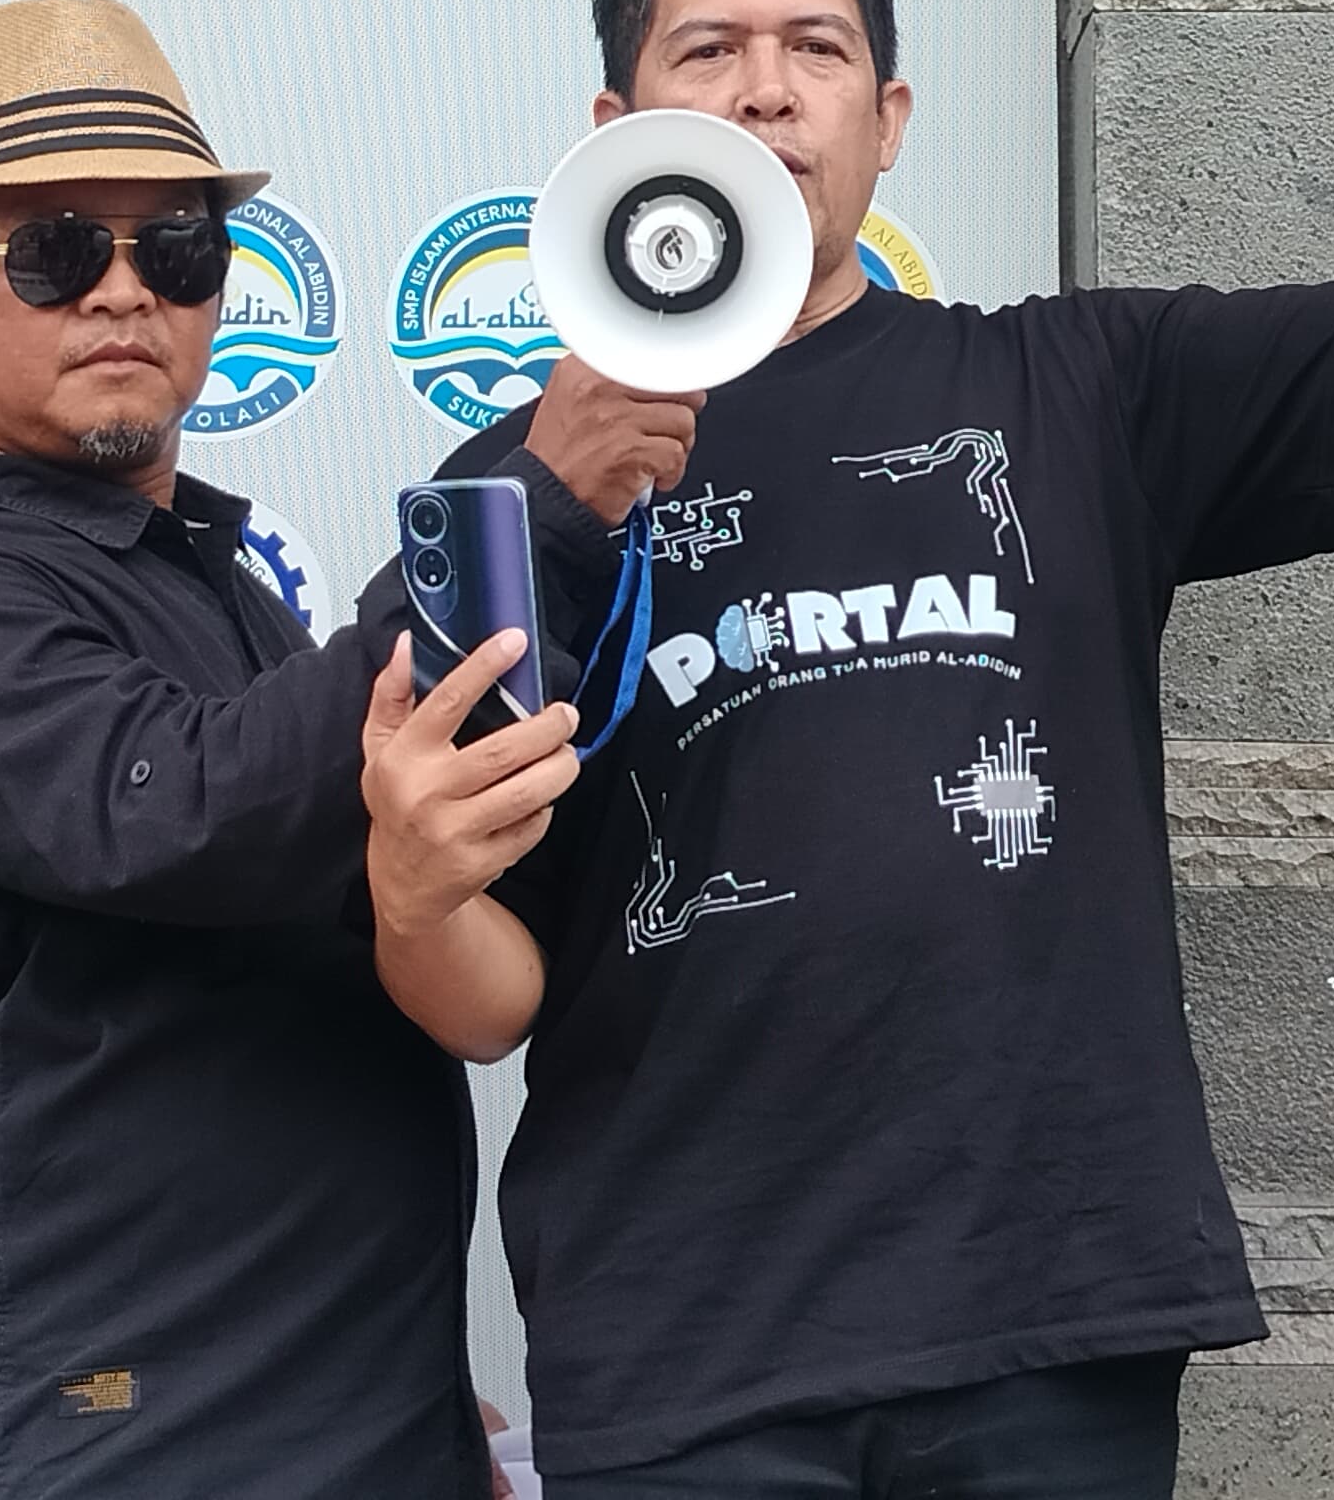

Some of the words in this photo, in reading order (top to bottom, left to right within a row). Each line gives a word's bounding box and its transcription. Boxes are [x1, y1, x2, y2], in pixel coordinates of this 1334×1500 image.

[448, 203, 538, 240] INTERNAS
[234, 203, 290, 238] IONAL
[288, 236, 311, 260] AL
[304, 262, 329, 326] ABIDIN
[410, 233, 452, 287] ISLAM
[872, 228, 895, 250] AL
[893, 251, 928, 296] ABID
[403, 289, 420, 331] SMP
[183, 392, 281, 428] OLALI
[677, 683, 762, 751] PERSATUAN
[768, 667, 827, 690] ORANG
[832, 657, 868, 676] TUA
[873, 650, 931, 670] MURID
